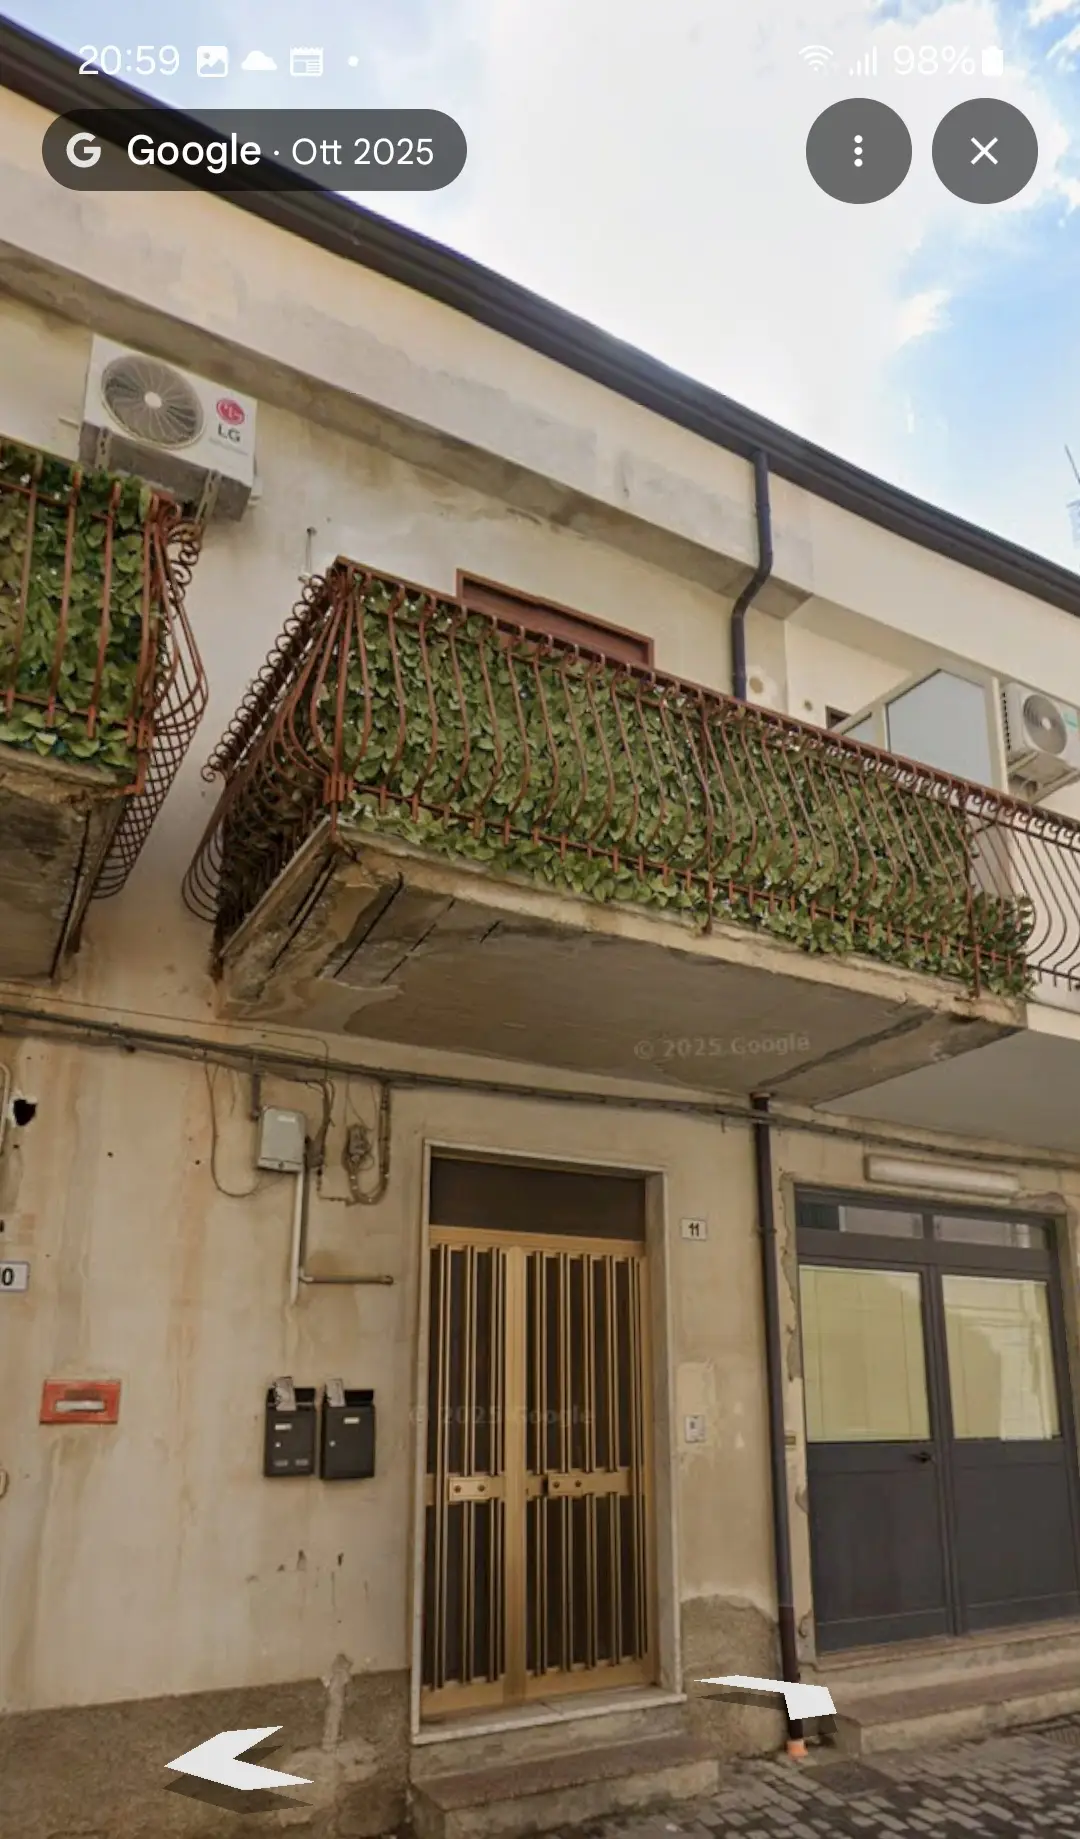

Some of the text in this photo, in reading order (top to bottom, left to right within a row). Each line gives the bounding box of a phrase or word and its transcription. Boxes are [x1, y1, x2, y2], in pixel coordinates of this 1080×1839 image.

[217, 422, 241, 443] LG
[688, 1222, 700, 1237] 11
[0, 1267, 15, 1287] 0
